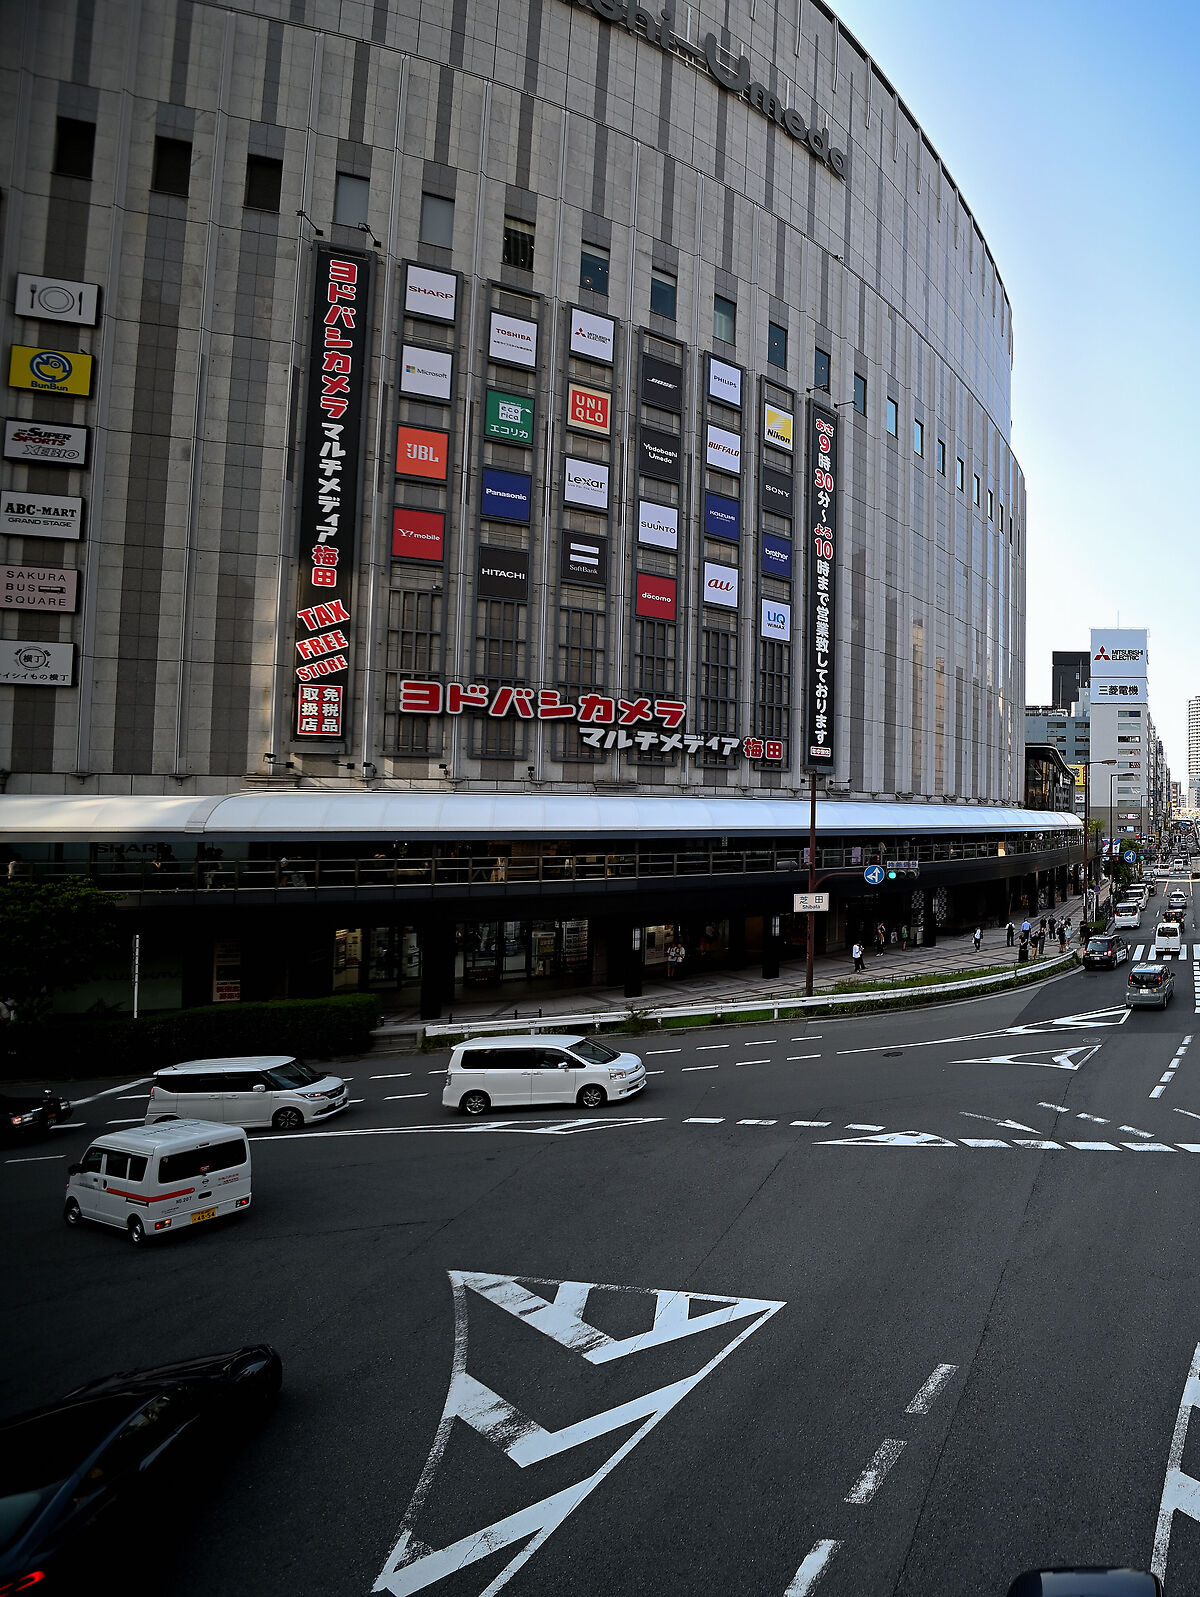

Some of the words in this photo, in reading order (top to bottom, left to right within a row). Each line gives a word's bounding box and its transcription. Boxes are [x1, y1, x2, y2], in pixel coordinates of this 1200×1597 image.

[408, 285, 453, 300] SHARP
[496, 327, 531, 342] TOSHIBA
[416, 367, 448, 379] Microsoft
[31, 381, 68, 392] BunBun
[647, 377, 678, 390] BOSE
[713, 375, 737, 389] PHILIPS
[501, 405, 519, 413] eco
[575, 394, 602, 410] UNI
[501, 411, 519, 421] rica
[575, 407, 604, 423] QLO
[27, 427, 71, 441] SUPER
[490, 424, 529, 439] エコリカ
[767, 428, 791, 444] Nikon
[12, 432, 66, 446] SPORTS
[23, 445, 79, 459] XEBIO
[406, 442, 439, 463] JBL
[643, 442, 678, 458] Yodobashi
[707, 441, 740, 457] BUFFALO
[648, 452, 673, 464] Umeda
[567, 472, 606, 489] Lexar
[485, 488, 527, 501] Panasonic
[765, 484, 790, 498] SONY
[4, 502, 77, 518] ABC-MART
[8, 517, 41, 525] GRAND
[42, 519, 72, 528] STAGE
[640, 523, 676, 534] SUUNTO
[765, 547, 788, 560] brother
[6, 570, 66, 582] SAKURA
[481, 567, 525, 580] HITACHI
[569, 564, 598, 575] SoftBank
[6, 583, 36, 592] BUS
[707, 577, 734, 592] au
[5, 595, 66, 606] SQUARE
[297, 598, 351, 632] TAX
[767, 611, 786, 625] UQ
[295, 630, 350, 662] FREE
[295, 654, 349, 682] STORE
[1098, 685, 1139, 696] 三菱電機
[301, 687, 319, 732] 取扱店
[321, 686, 340, 733] 免税品
[399, 679, 687, 728] ヨドバシカメラ
[799, 895, 823, 905] 芝田
